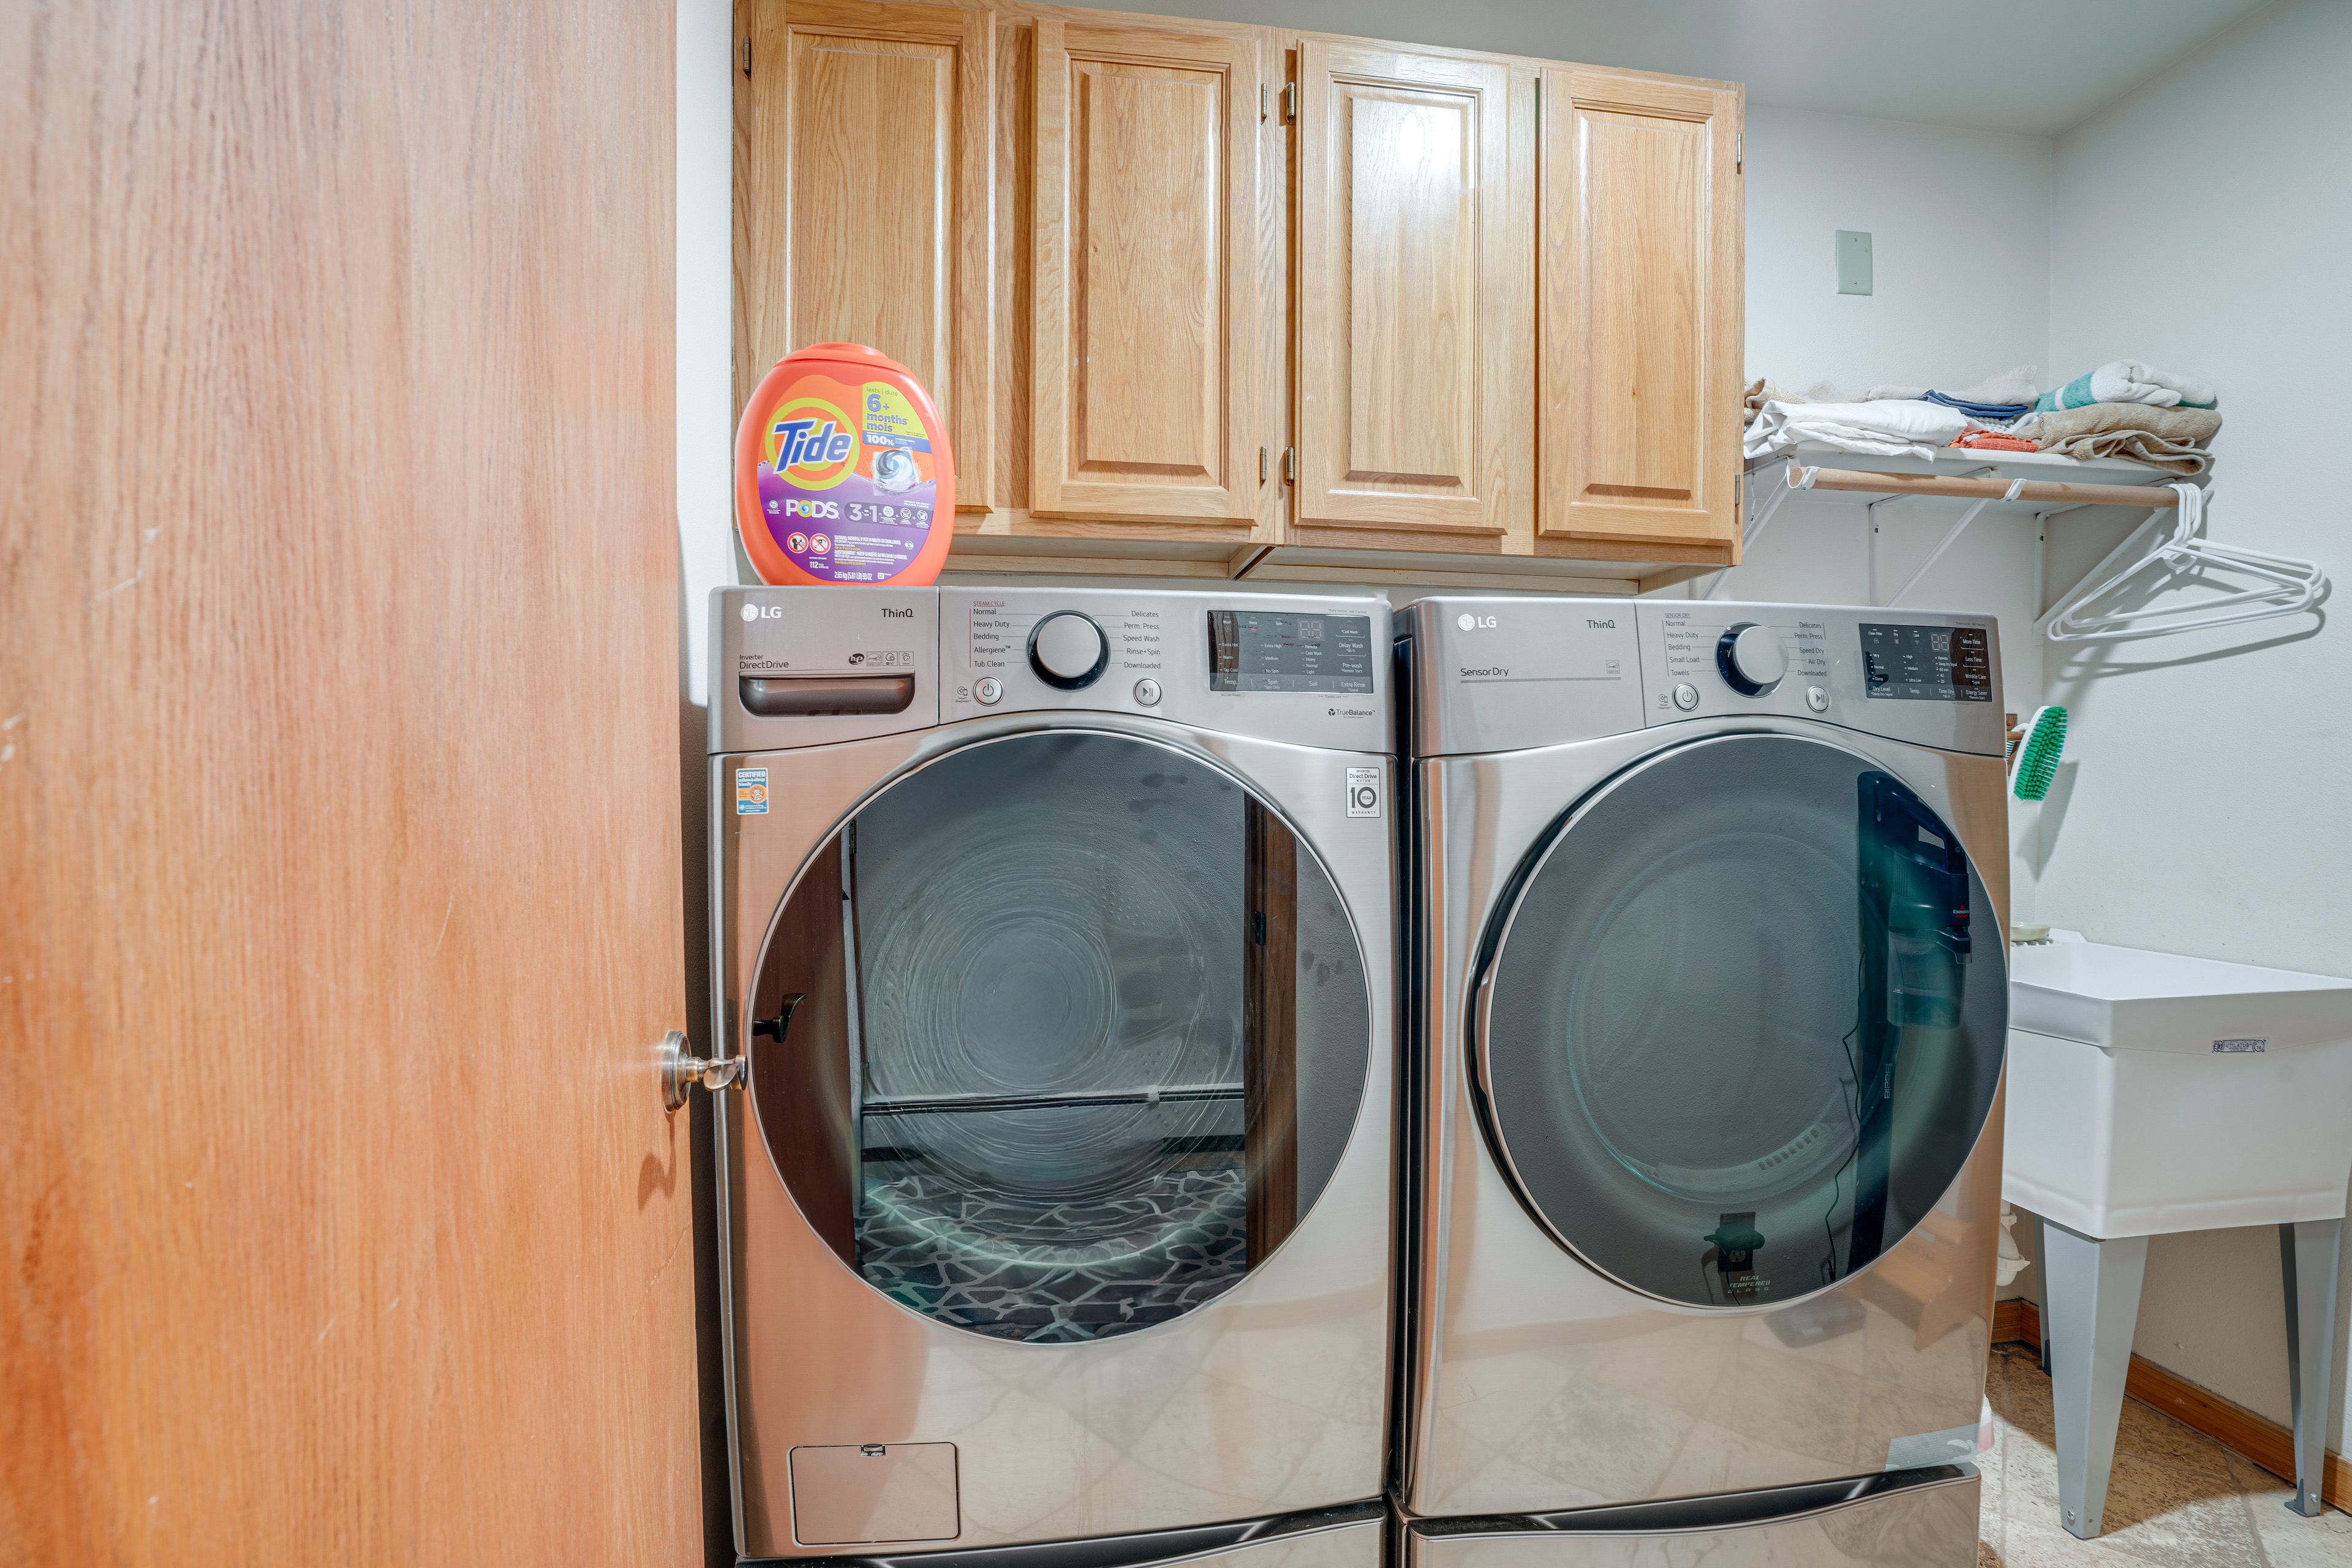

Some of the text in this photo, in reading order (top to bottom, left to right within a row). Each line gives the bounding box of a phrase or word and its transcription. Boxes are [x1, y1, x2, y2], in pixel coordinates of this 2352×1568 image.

[867, 413, 908, 425] months
[867, 423, 893, 432] mois
[773, 418, 853, 473] Tide
[867, 434, 894, 446] 100%
[786, 499, 839, 519] PODS
[761, 606, 782, 619] LG
[881, 608, 914, 618] ThinQ
[1477, 616, 1497, 628] LG
[1586, 620, 1616, 628] ThinQ
[1350, 786, 1376, 809] 10
